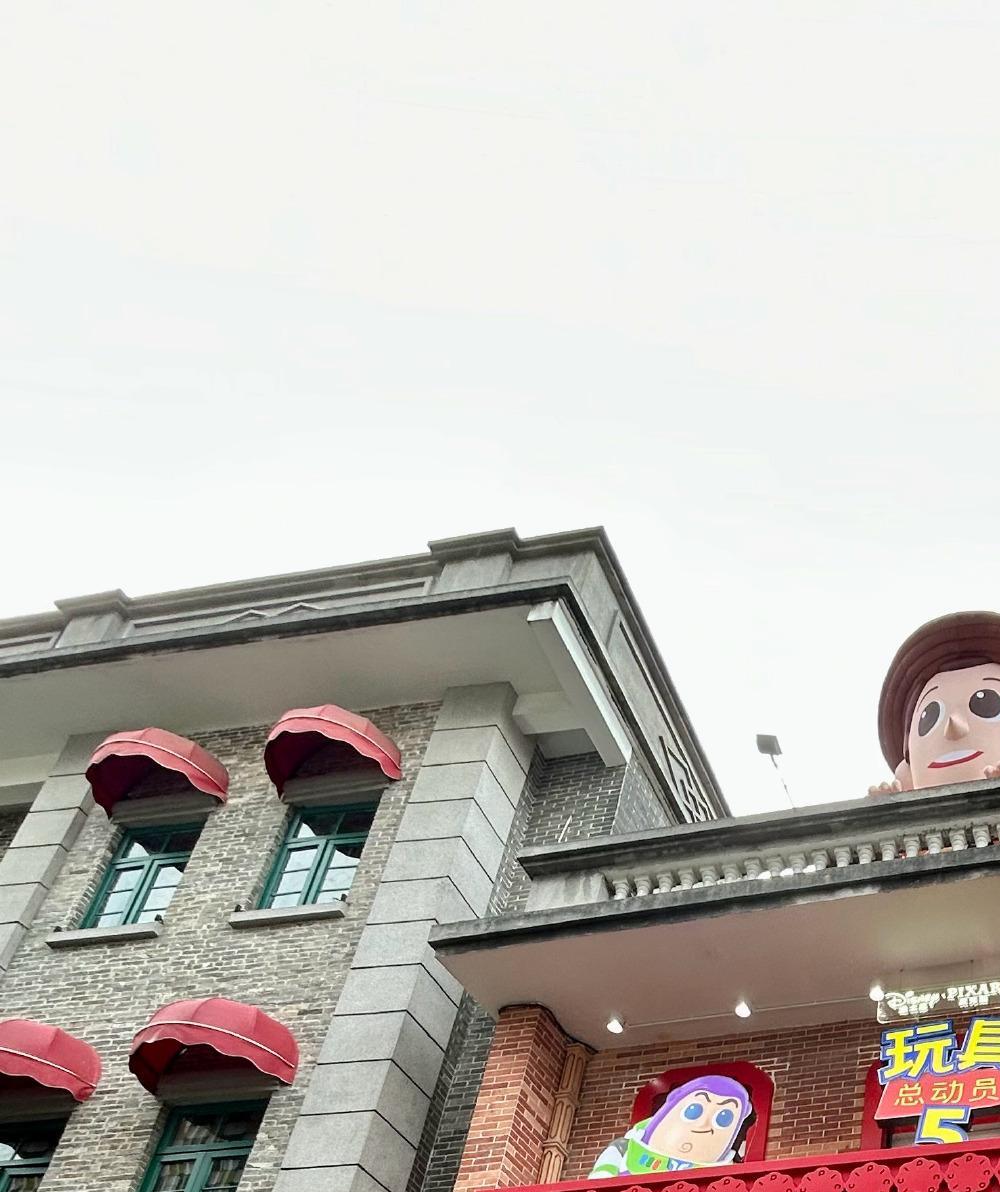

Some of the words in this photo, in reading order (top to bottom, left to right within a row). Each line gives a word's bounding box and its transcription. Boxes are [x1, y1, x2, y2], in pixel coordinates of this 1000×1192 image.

[894, 1077, 999, 1106] 总动员
[920, 1108, 966, 1144] 5
